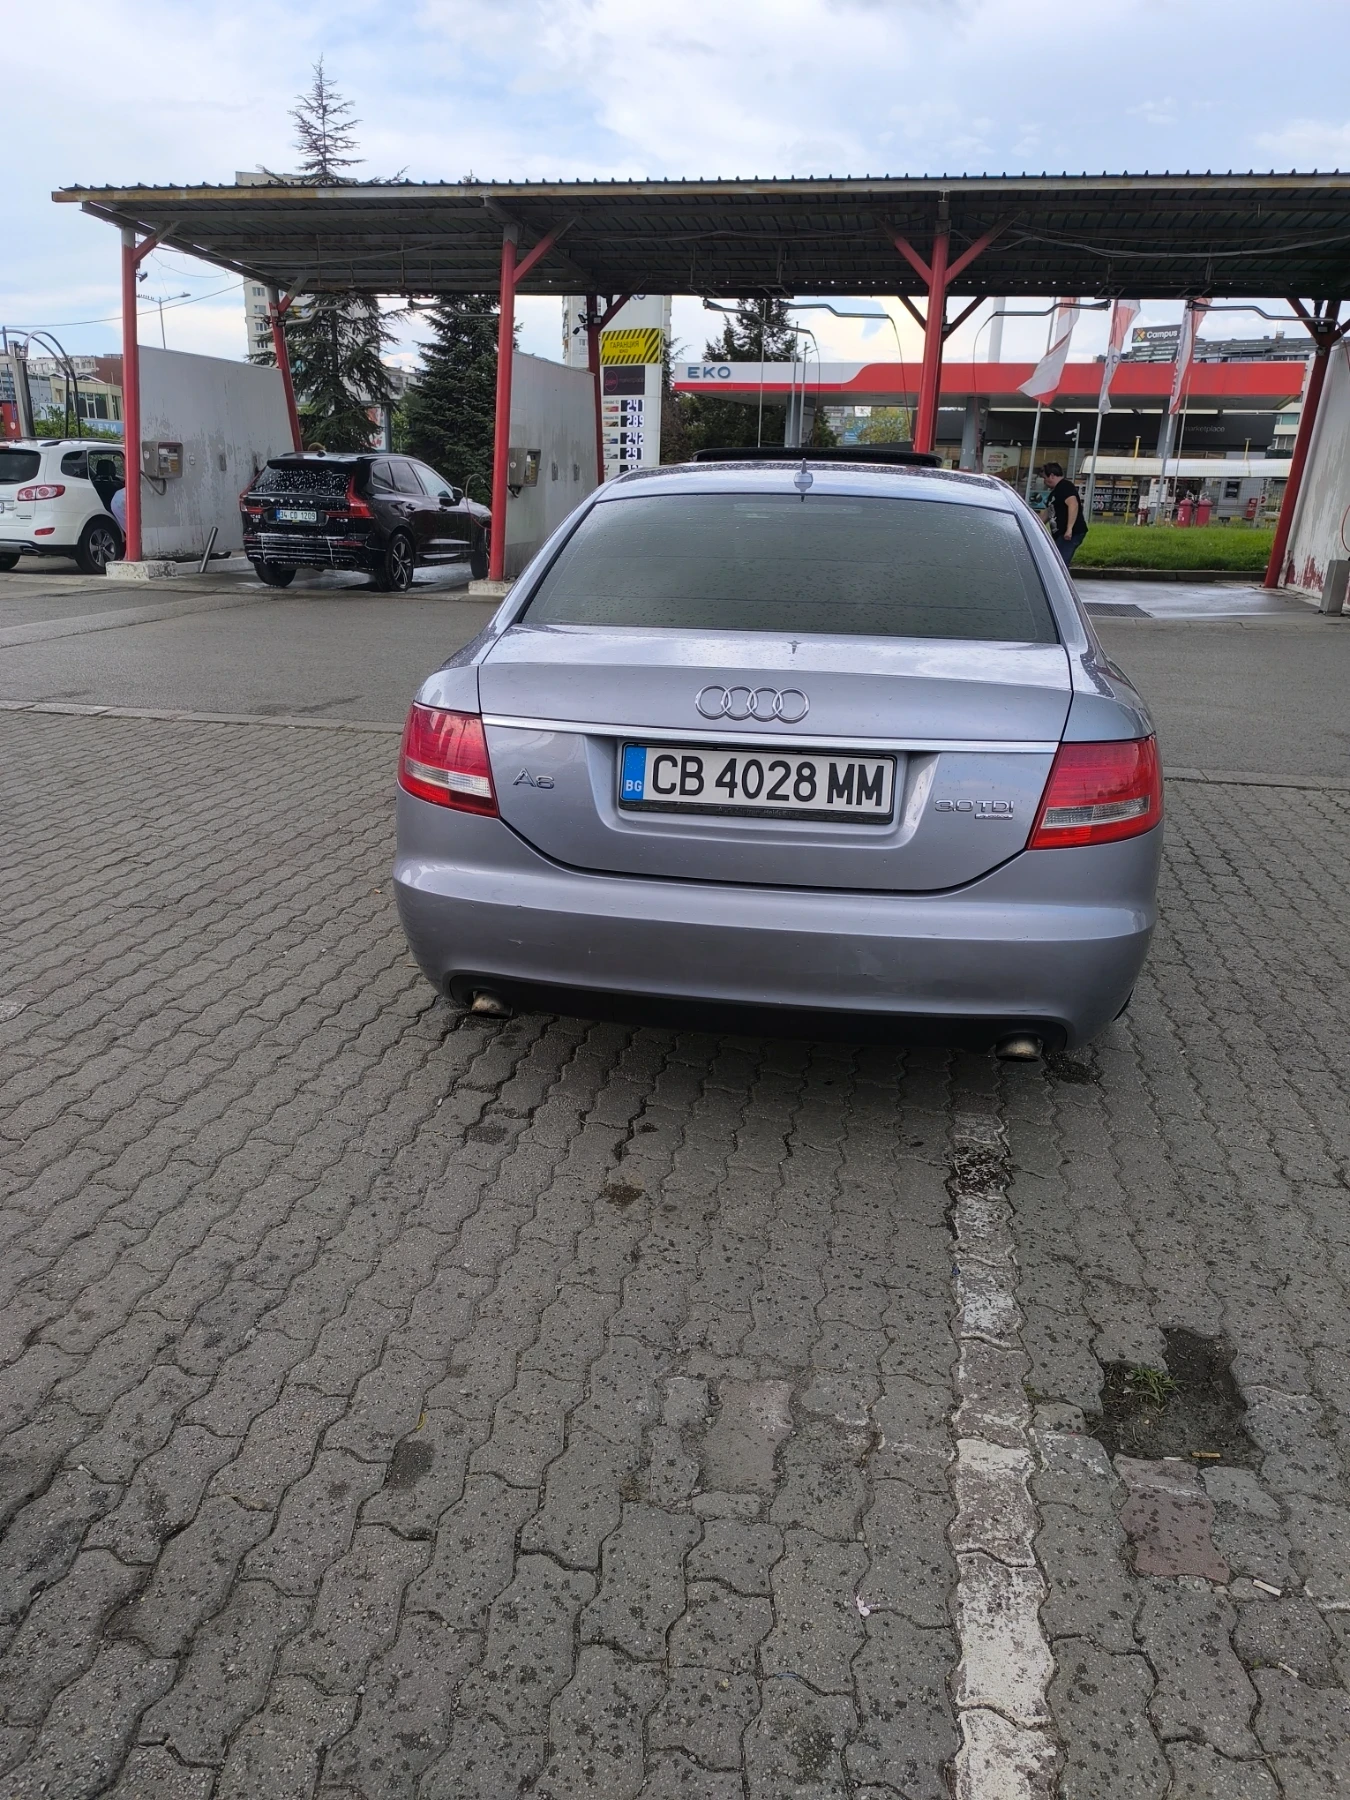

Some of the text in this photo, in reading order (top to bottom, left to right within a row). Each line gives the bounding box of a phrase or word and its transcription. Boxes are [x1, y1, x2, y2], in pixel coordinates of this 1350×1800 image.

[1146, 329, 1178, 339] Campus
[609, 340, 640, 349] ГАРАНЦИЯ
[687, 366, 731, 379] EKO
[280, 510, 287, 519] 34
[301, 511, 316, 520] 1209
[512, 767, 555, 789] A6
[651, 753, 885, 807] CB 4028 MM
[625, 779, 643, 793] BG
